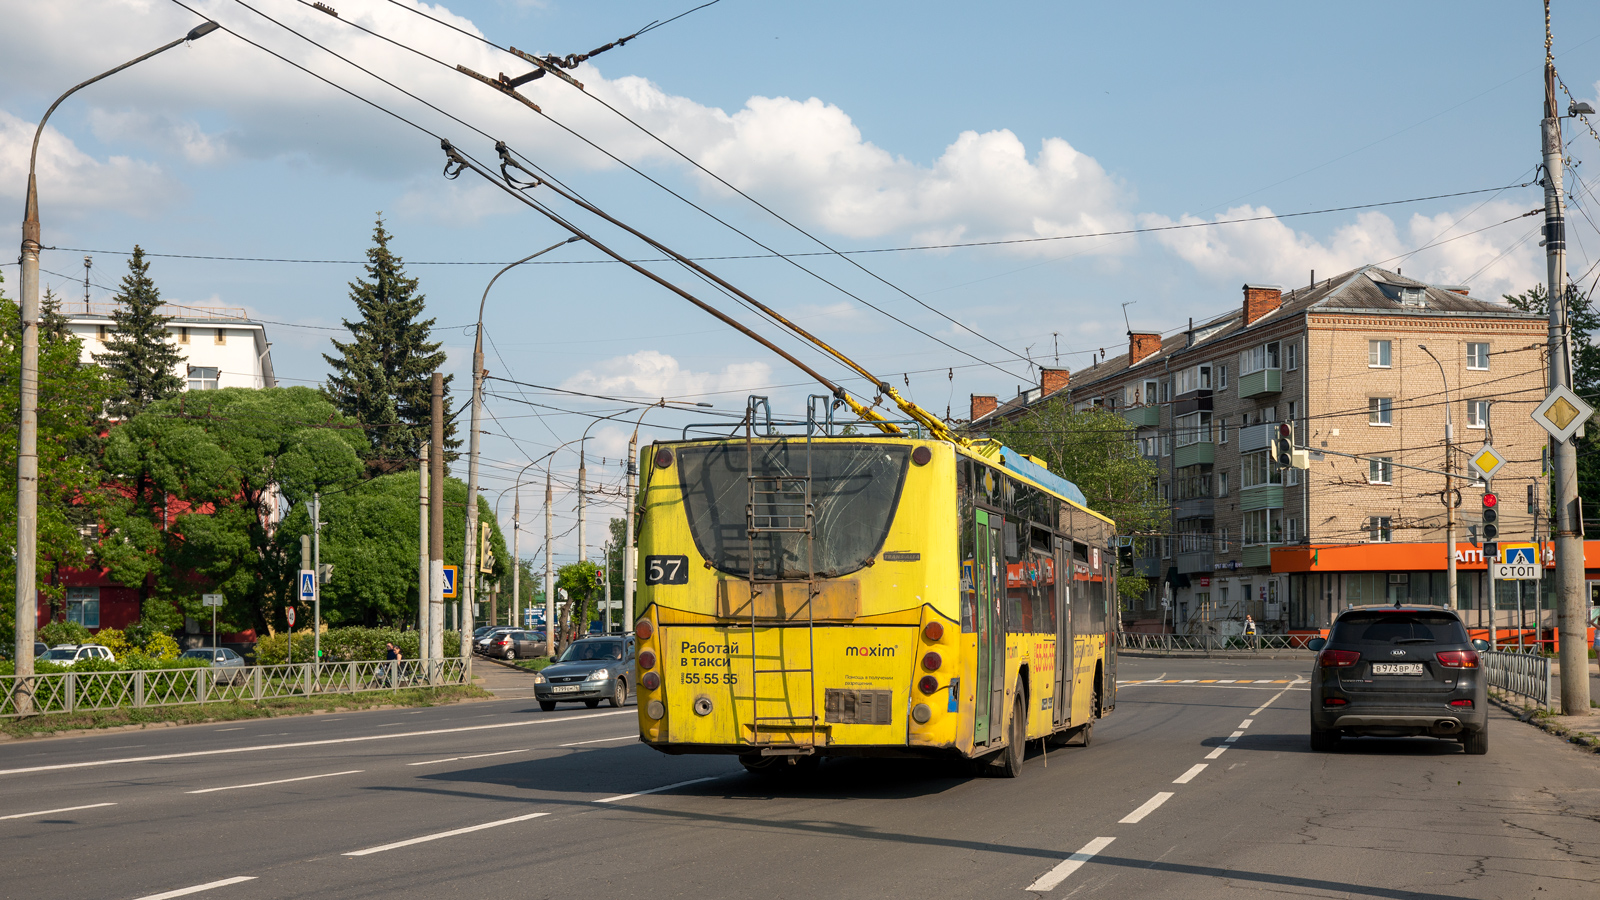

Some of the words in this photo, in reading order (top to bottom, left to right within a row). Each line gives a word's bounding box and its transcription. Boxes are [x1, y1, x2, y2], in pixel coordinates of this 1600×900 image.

[649, 557, 683, 581] 57
[1500, 567, 1535, 577] СТОП
[680, 641, 739, 655] Работай
[680, 657, 688, 667] в
[691, 657, 731, 667] такси
